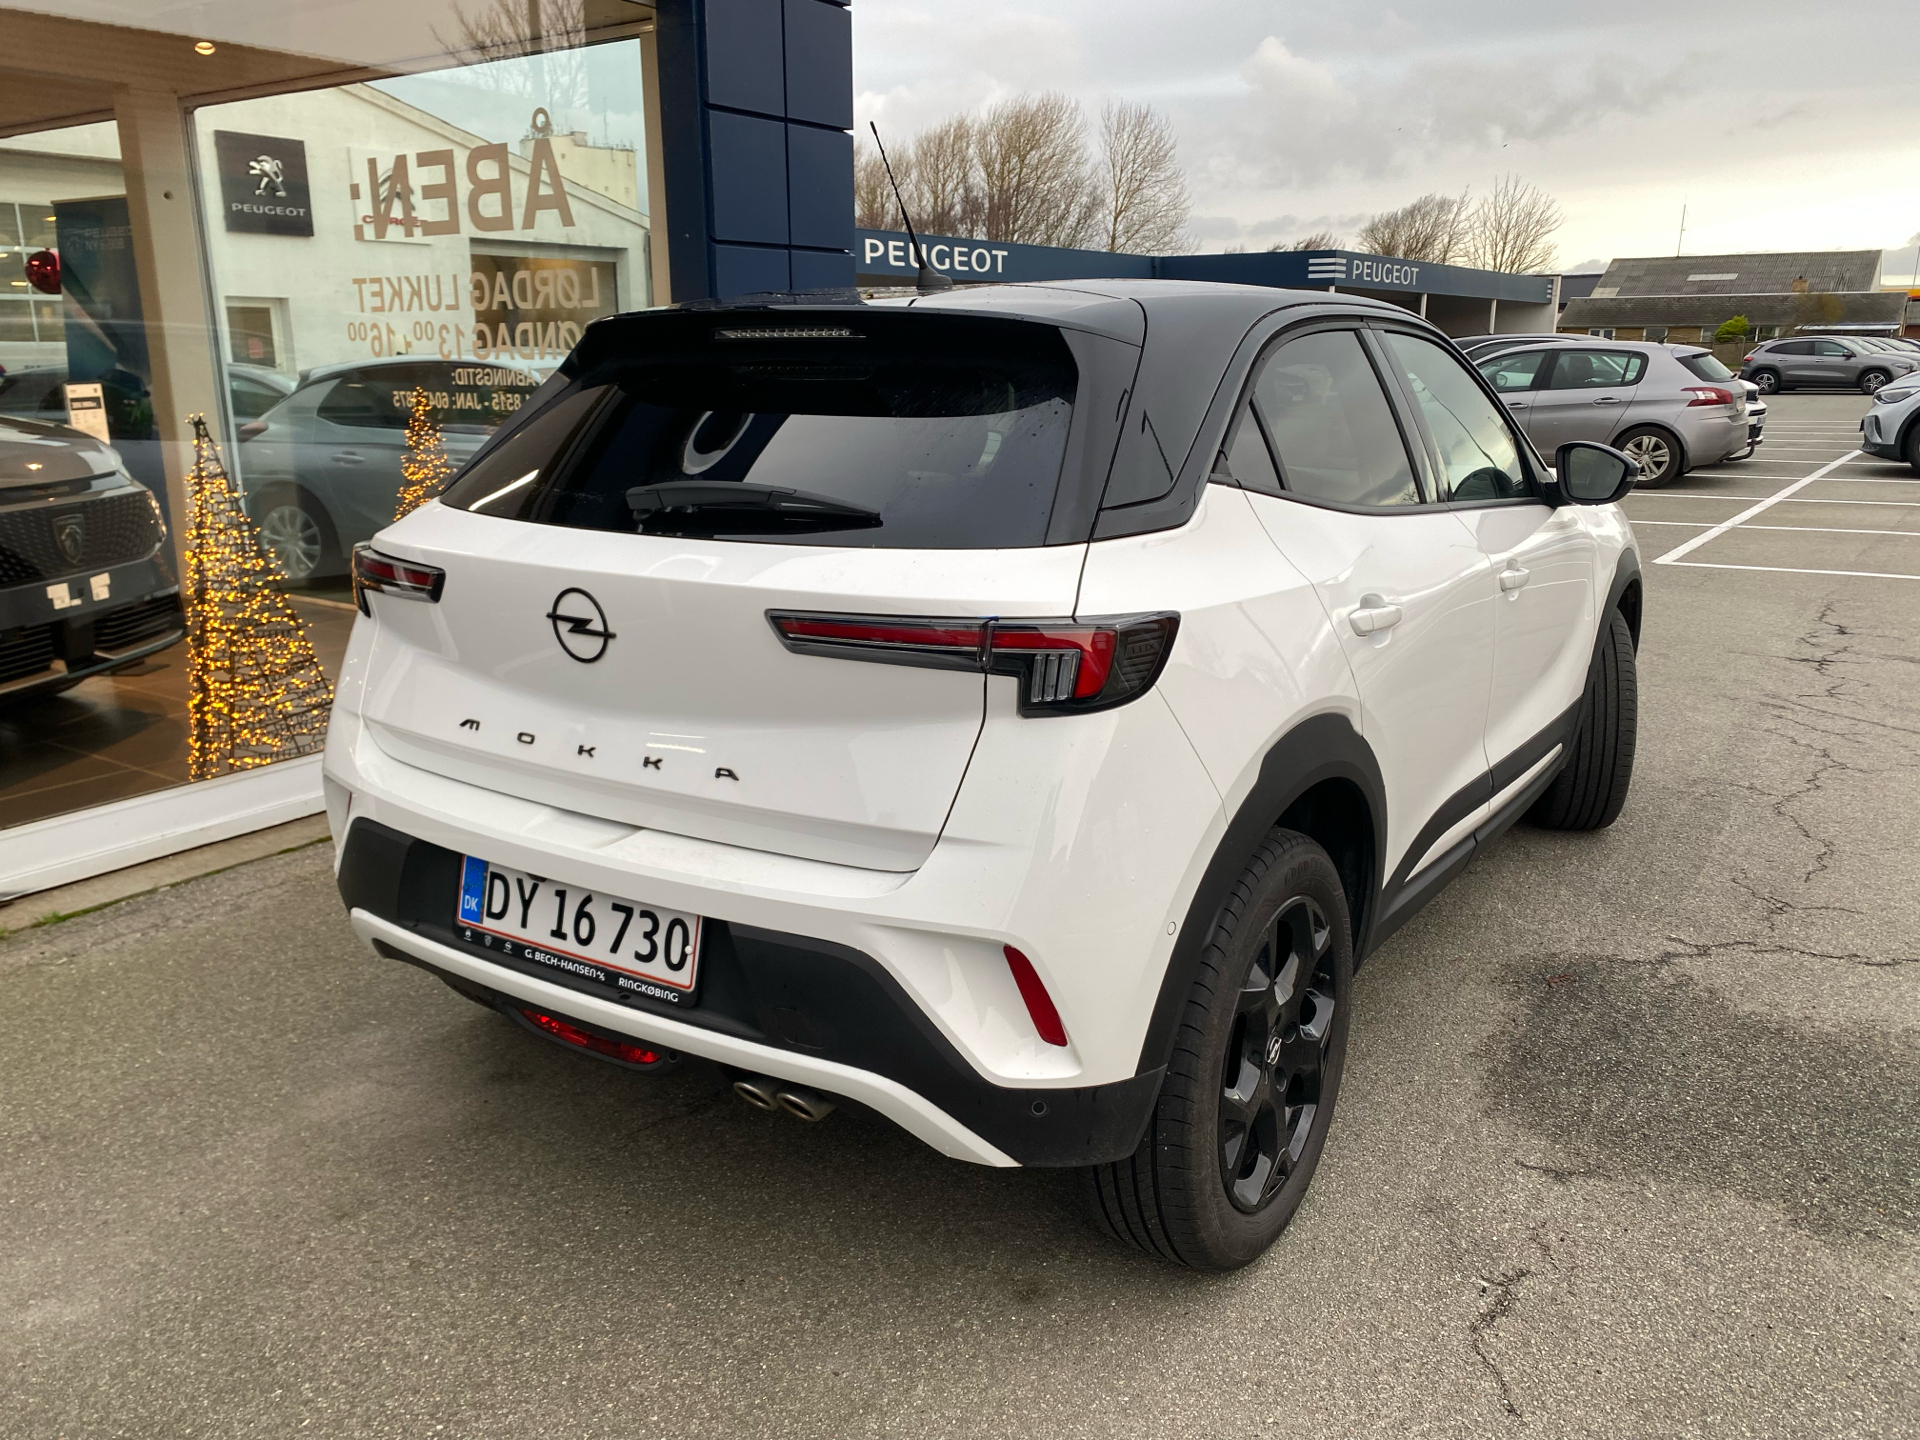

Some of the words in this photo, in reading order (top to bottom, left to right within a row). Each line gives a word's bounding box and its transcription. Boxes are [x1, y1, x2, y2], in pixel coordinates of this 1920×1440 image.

[231, 202, 306, 217] PEUGEOT
[864, 238, 1008, 273] PEUGEOT
[1352, 259, 1419, 286] PEUGEOT
[459, 718, 740, 782] MOKKA
[464, 894, 478, 912] DK
[485, 870, 540, 930] DY
[550, 889, 596, 947] 16
[609, 902, 690, 973] 730
[618, 977, 679, 1003] RINGKØBING
